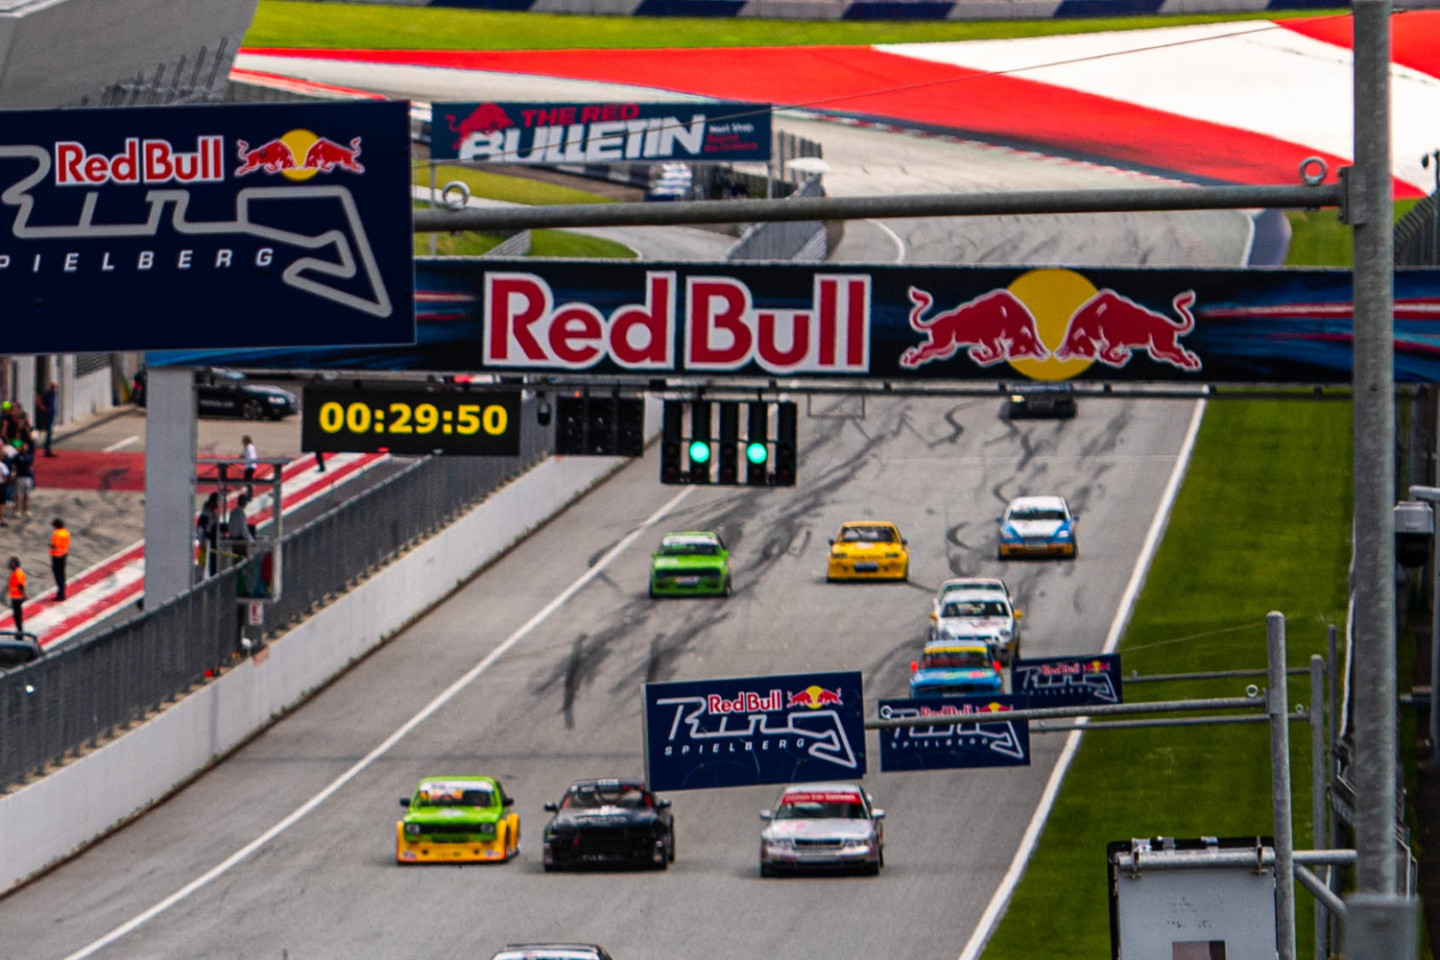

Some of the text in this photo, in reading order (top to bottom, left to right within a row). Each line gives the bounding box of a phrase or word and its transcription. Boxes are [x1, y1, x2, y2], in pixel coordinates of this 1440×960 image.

[521, 103, 640, 127] THE RED
[459, 114, 706, 162] BULLETIN
[56, 135, 224, 186] Red Bull
[483, 270, 871, 375] Red Bull
[318, 401, 509, 437] 00:29:50
[708, 690, 782, 714] Red Bull
[664, 738, 805, 756] SPIELBERG
